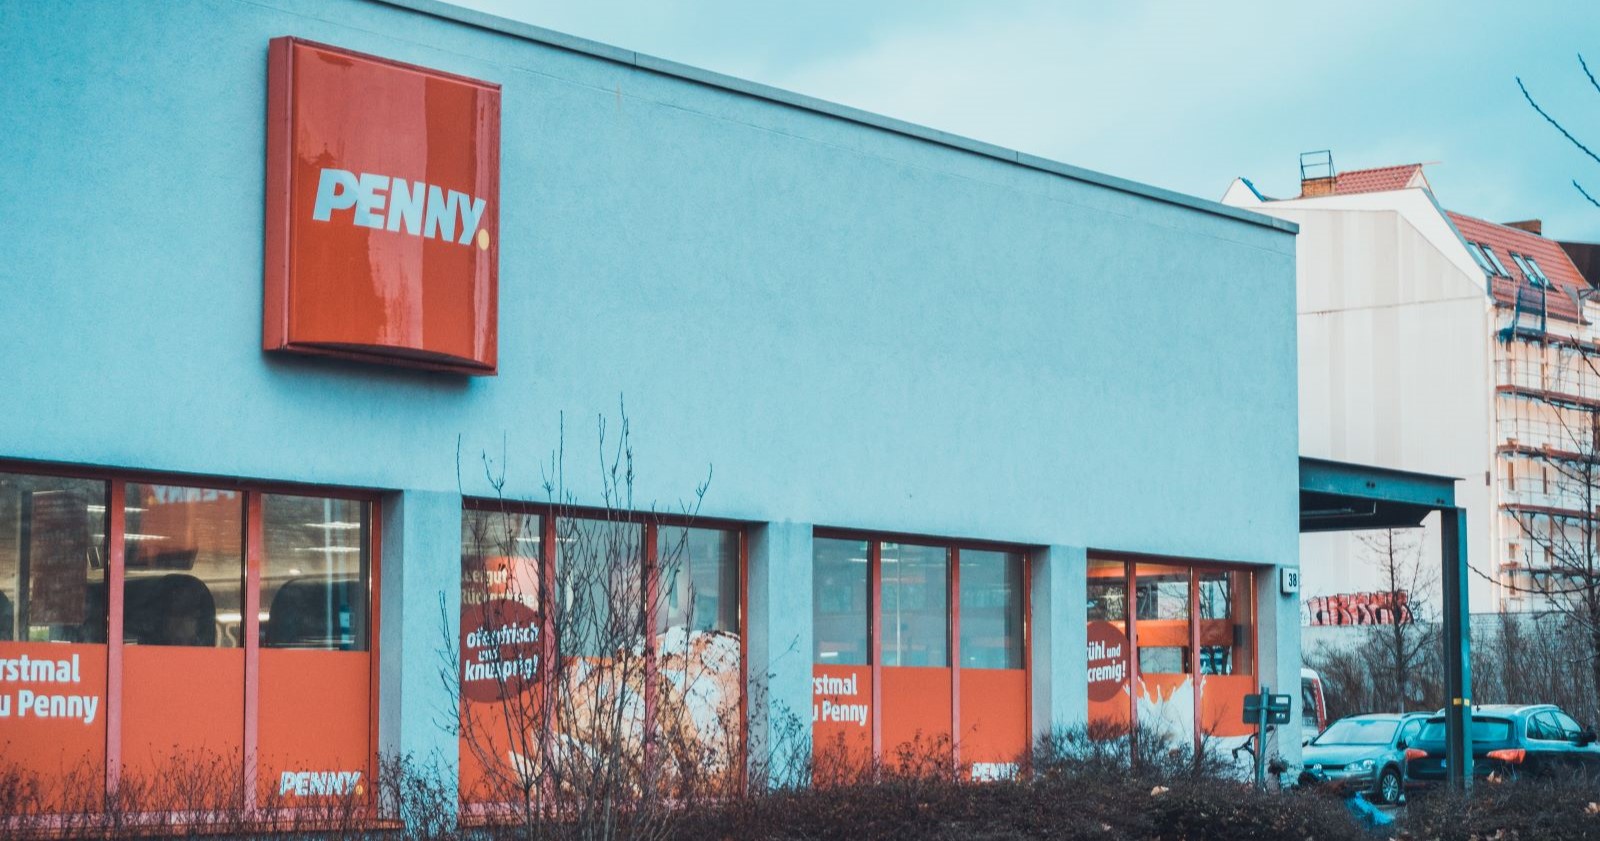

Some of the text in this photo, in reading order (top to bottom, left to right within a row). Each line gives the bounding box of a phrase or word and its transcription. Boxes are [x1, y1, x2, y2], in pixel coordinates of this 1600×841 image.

[1288, 572, 1297, 587] 38
[1087, 640, 1121, 661] ühl und
[1087, 659, 1126, 683] cremig!
[18, 689, 99, 724] Penny
[822, 700, 868, 727] Penny
